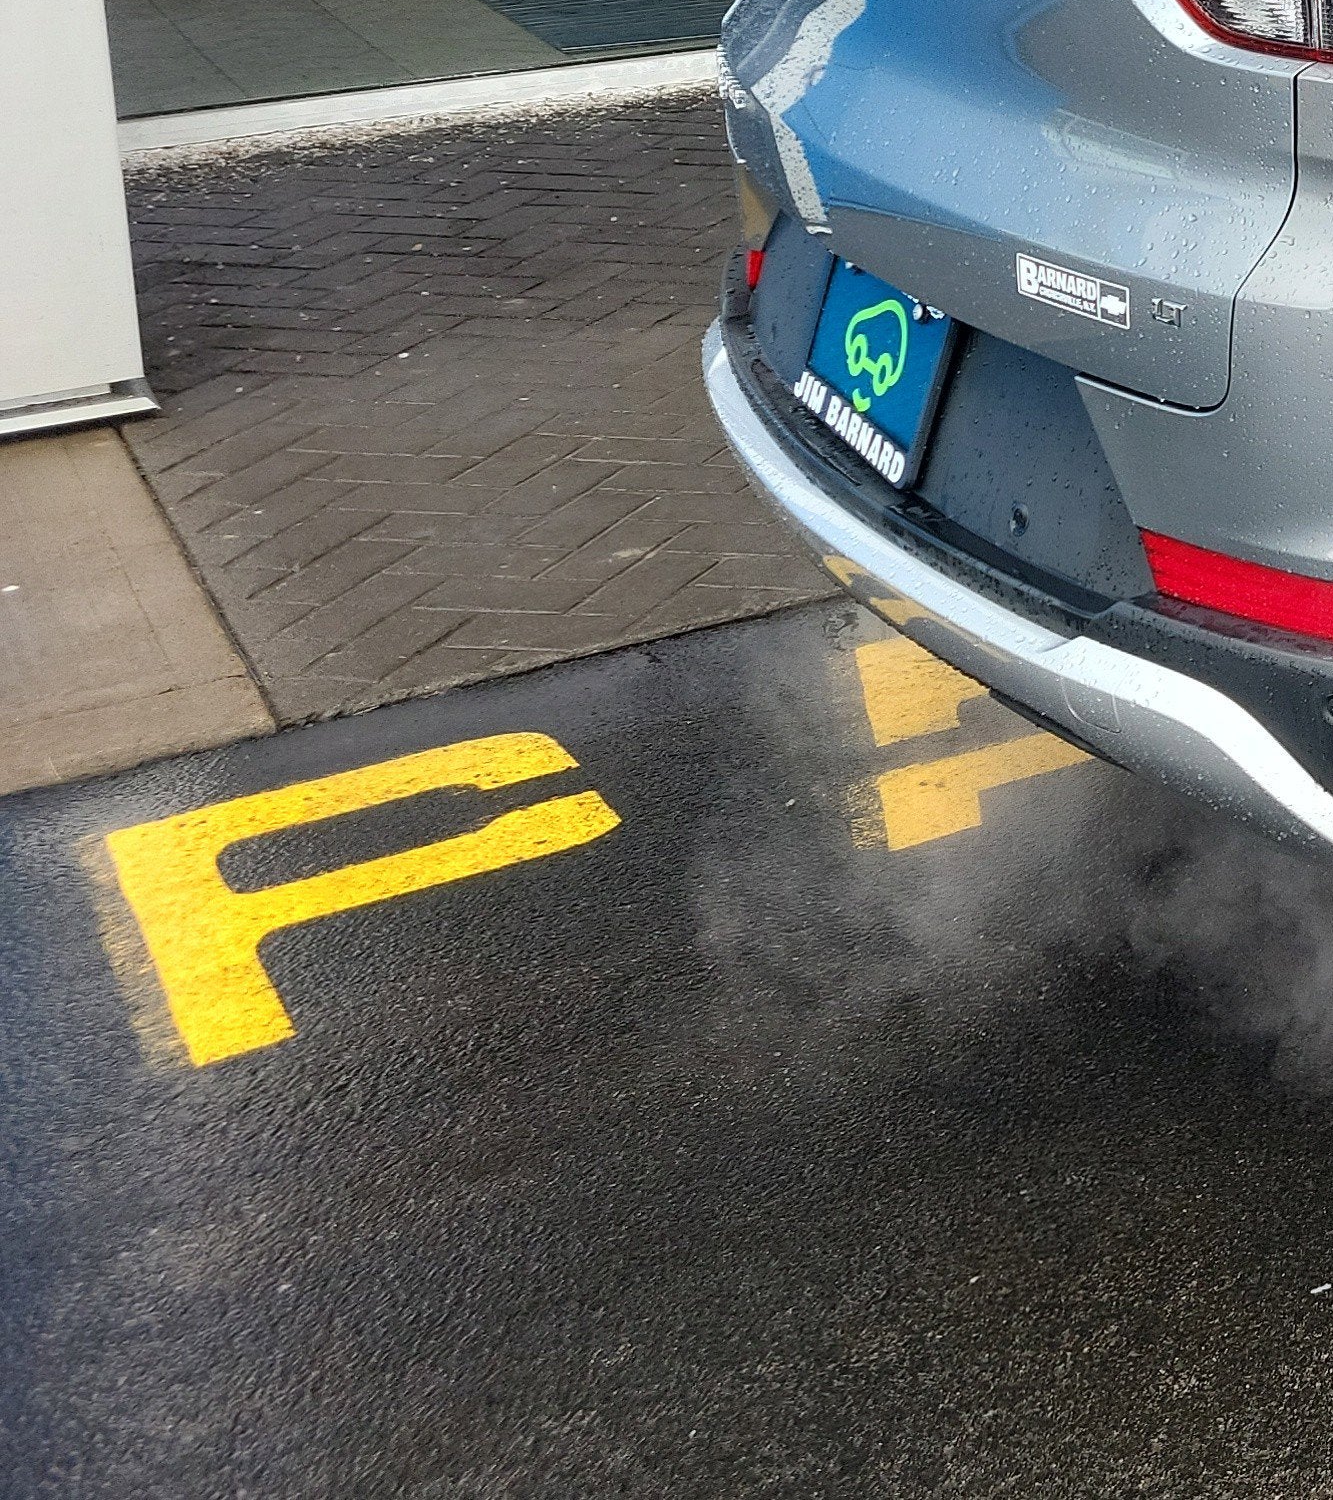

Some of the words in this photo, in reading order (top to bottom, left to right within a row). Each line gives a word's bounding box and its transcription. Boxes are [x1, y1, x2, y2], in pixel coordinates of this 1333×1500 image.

[1019, 258, 1097, 301] BARNARD
[1151, 297, 1189, 328] LT
[793, 370, 828, 414] JIM
[823, 395, 906, 484] BARNARD
